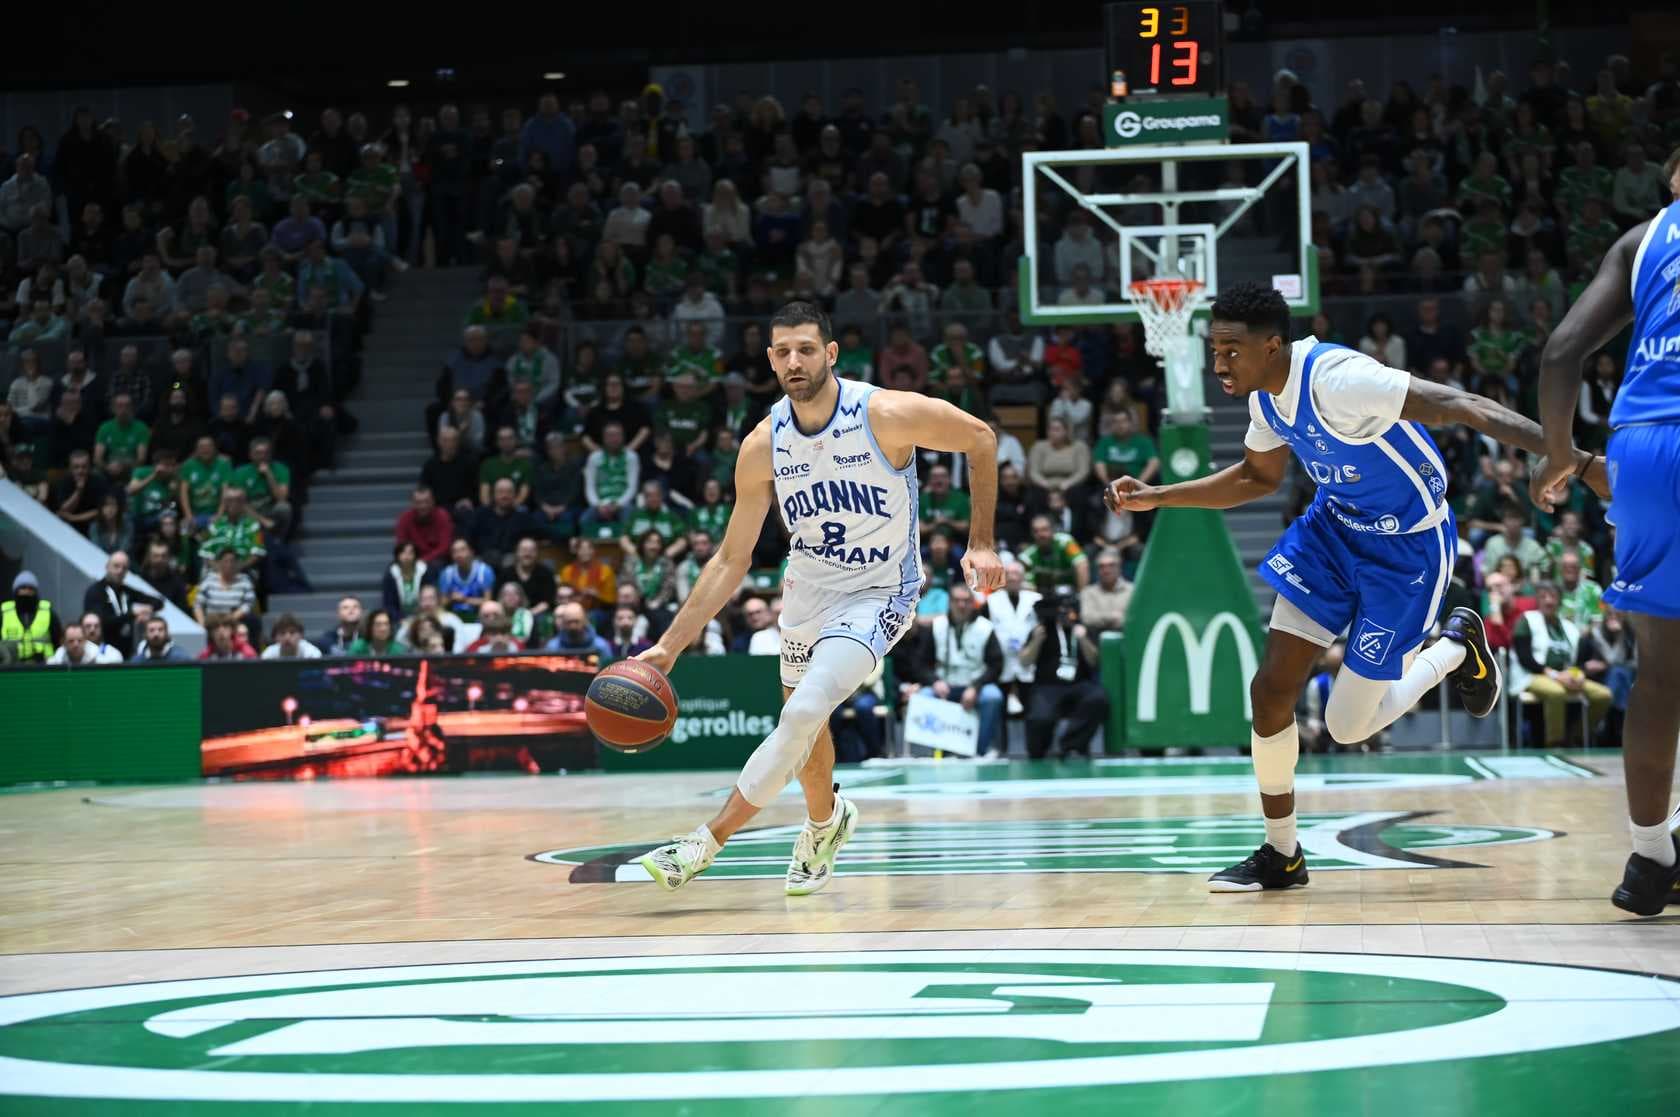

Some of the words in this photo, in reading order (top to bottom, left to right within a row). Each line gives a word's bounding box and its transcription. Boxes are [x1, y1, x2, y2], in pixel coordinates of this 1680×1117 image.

[1139, 7, 1159, 37] 3
[1169, 6, 1189, 36] 3
[1150, 40, 1198, 86] 13
[1142, 114, 1221, 131] Groupama
[774, 463, 810, 478] Loire
[832, 451, 871, 465] Roanne
[783, 479, 892, 526] ROANNE
[820, 521, 847, 546] 8
